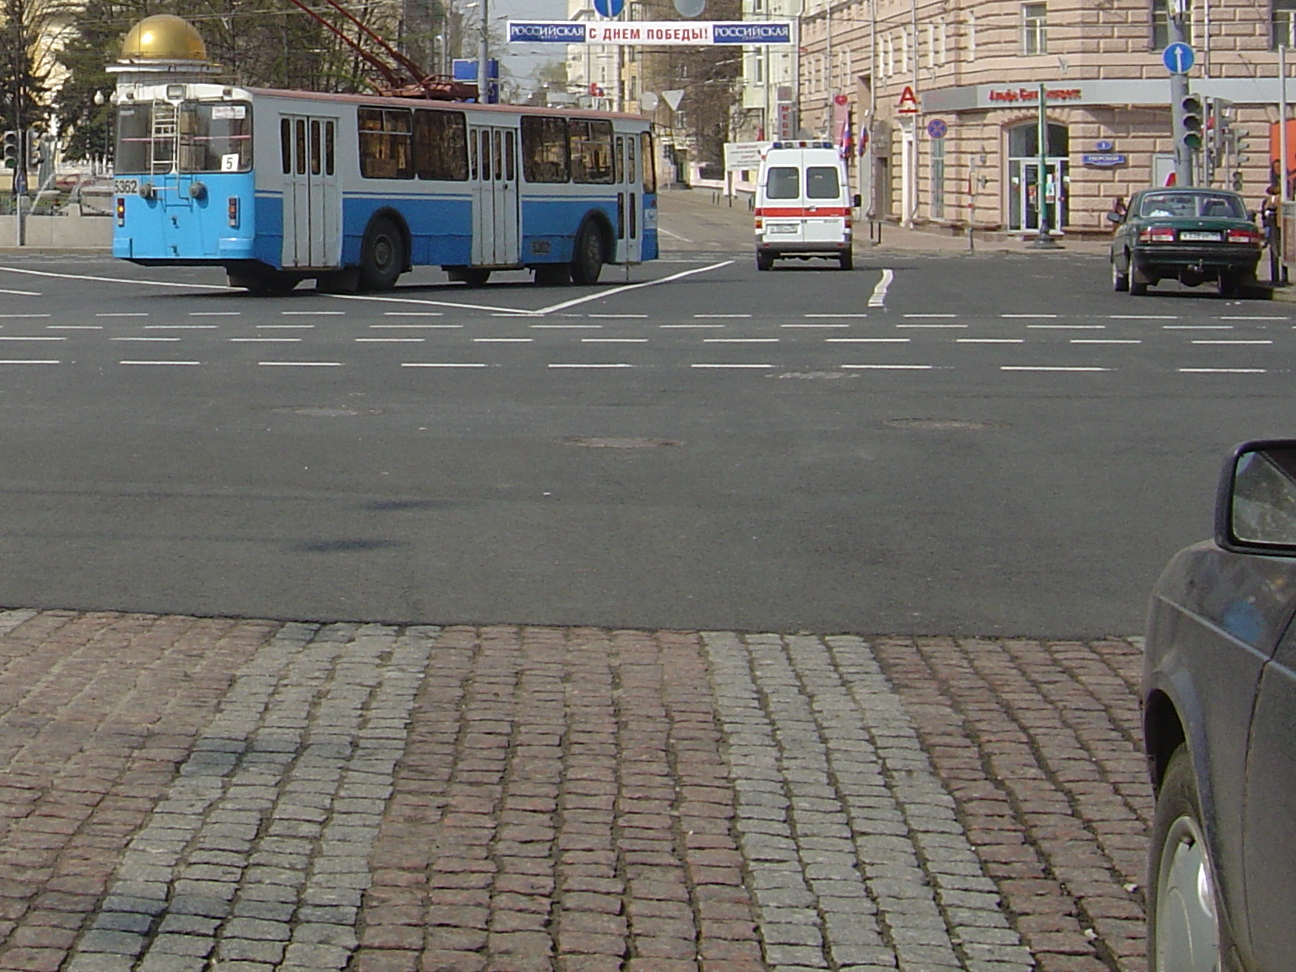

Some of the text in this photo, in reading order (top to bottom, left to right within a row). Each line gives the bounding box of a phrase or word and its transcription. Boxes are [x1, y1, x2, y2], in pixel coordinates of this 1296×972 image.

[511, 25, 584, 37] РОССИЙСКАЯ
[589, 28, 708, 42] С ДНЕМ ПОБЕДЫ!
[714, 25, 788, 37] РОССИЙСКАЯ
[226, 157, 234, 170] 5
[114, 179, 138, 194] 5362
